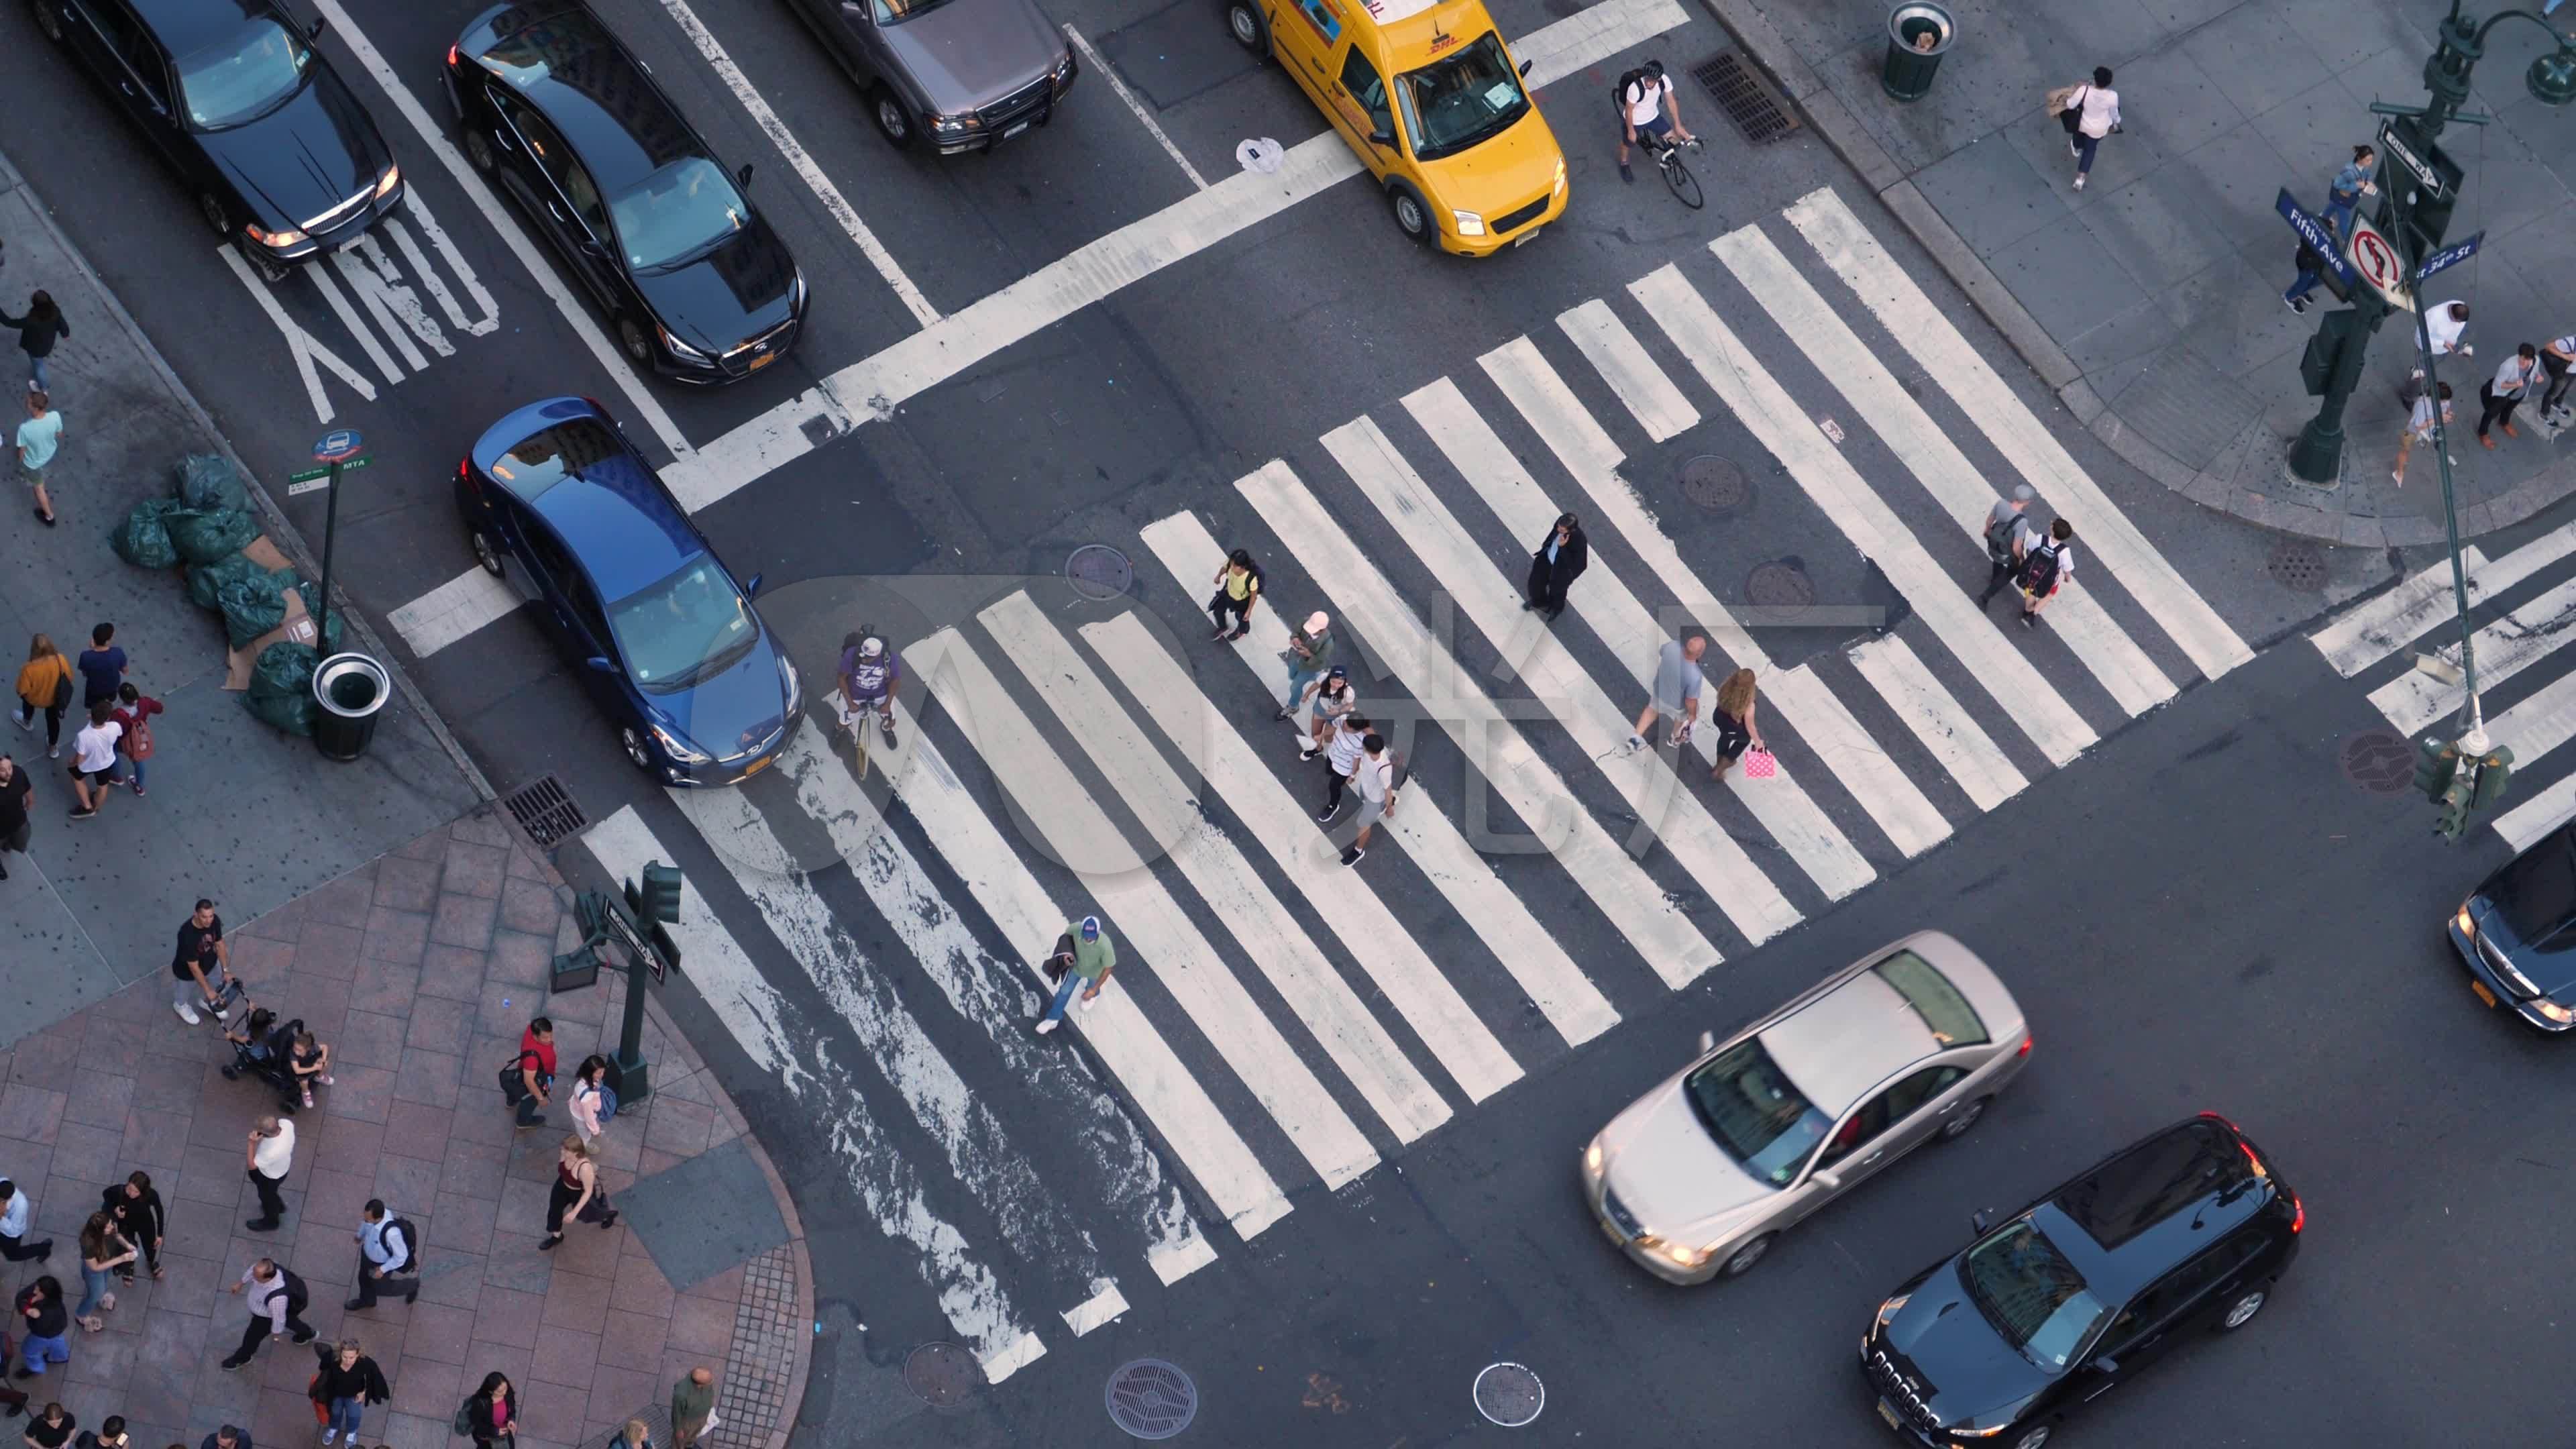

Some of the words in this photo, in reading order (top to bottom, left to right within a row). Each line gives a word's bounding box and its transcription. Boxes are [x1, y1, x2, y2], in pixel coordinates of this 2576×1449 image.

[1430, 37, 1458, 54] DHL
[2392, 138, 2408, 156] ONE
[2415, 161, 2432, 181] WAY
[2290, 209, 2318, 244] Fifth
[2319, 244, 2344, 273] Ave
[2428, 252, 2454, 274] 34th
[2456, 245, 2471, 260] St
[343, 460, 365, 470] MTA
[615, 915, 628, 932] ONE
[638, 943, 654, 961] WAY
